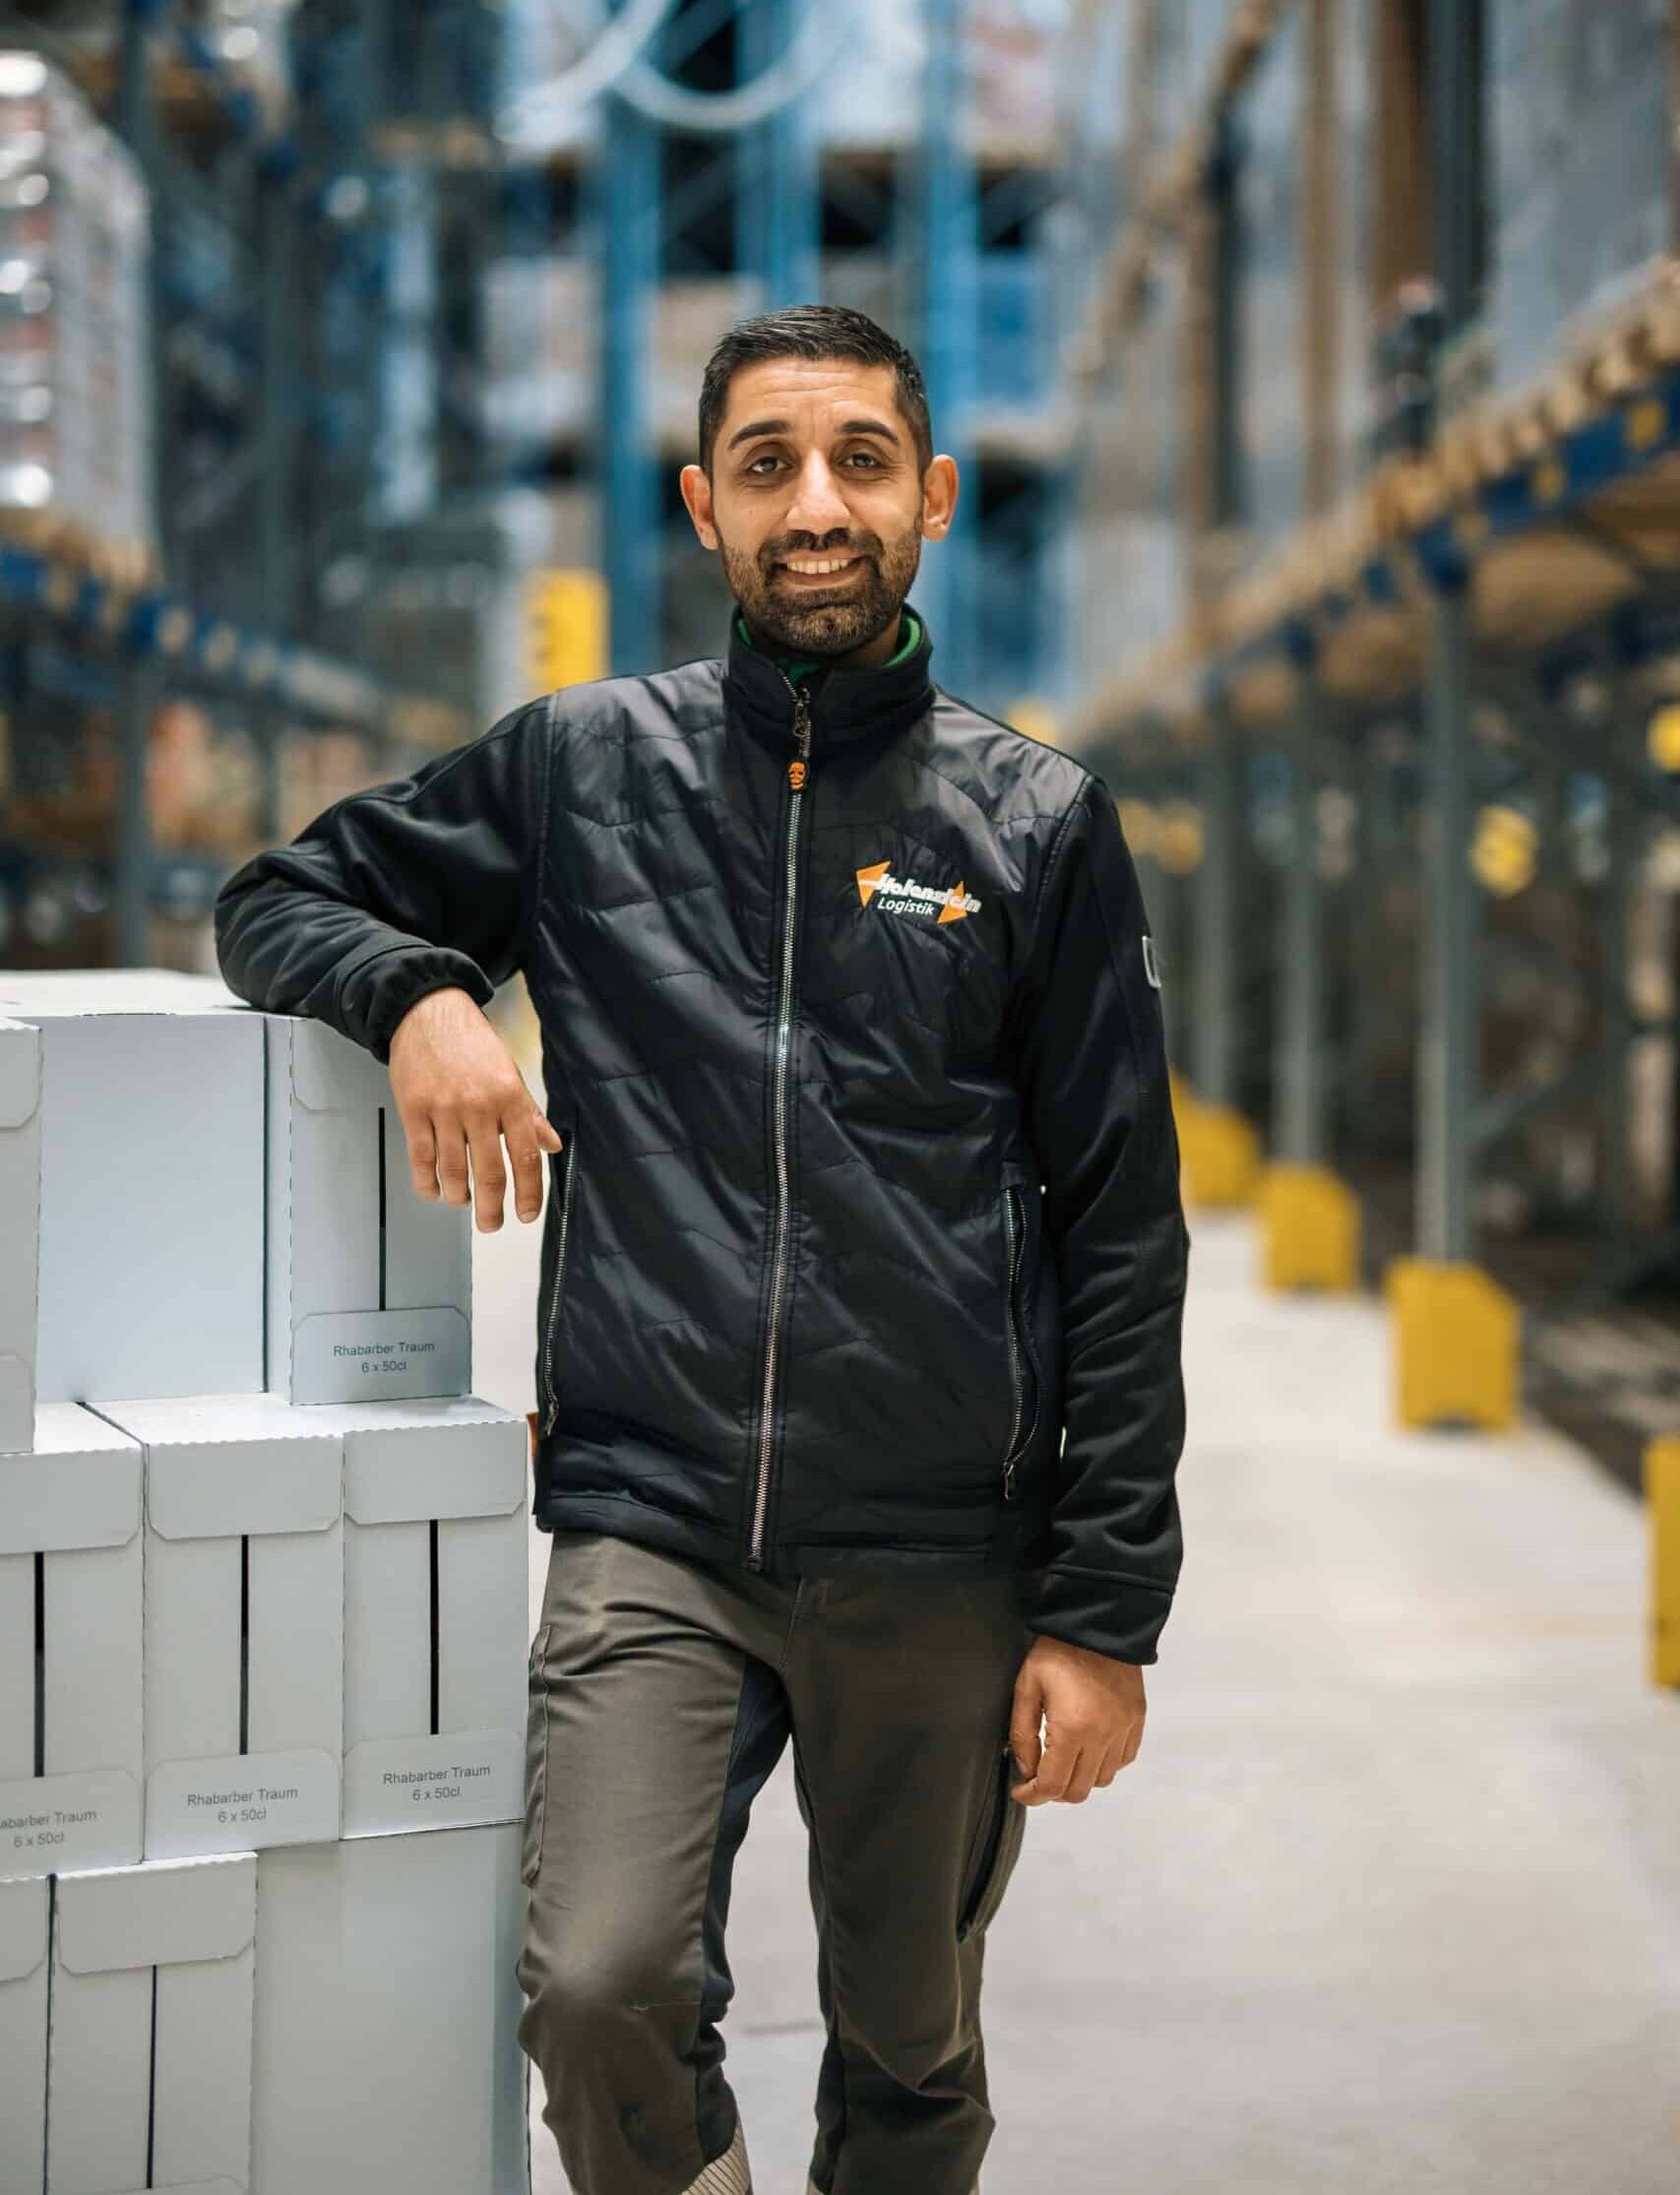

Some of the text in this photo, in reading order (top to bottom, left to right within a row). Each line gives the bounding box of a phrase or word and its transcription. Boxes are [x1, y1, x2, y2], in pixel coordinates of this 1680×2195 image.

[877, 897, 934, 915] Logistik
[333, 1342, 435, 1357] Rhabarber Traum
[361, 1361, 370, 1373] 6
[382, 1360, 407, 1372] 50cl
[383, 1766, 490, 1785] Rhabarber Traum
[187, 1787, 298, 1806] Rhabarber Traum
[412, 1788, 420, 1800] 6
[435, 1787, 461, 1799] 50cl
[0, 1811, 96, 1828] abarber Traum
[218, 1810, 226, 1823] 6
[241, 1808, 267, 1821] 50cl
[14, 1832, 64, 1848] 6 x 50cl
